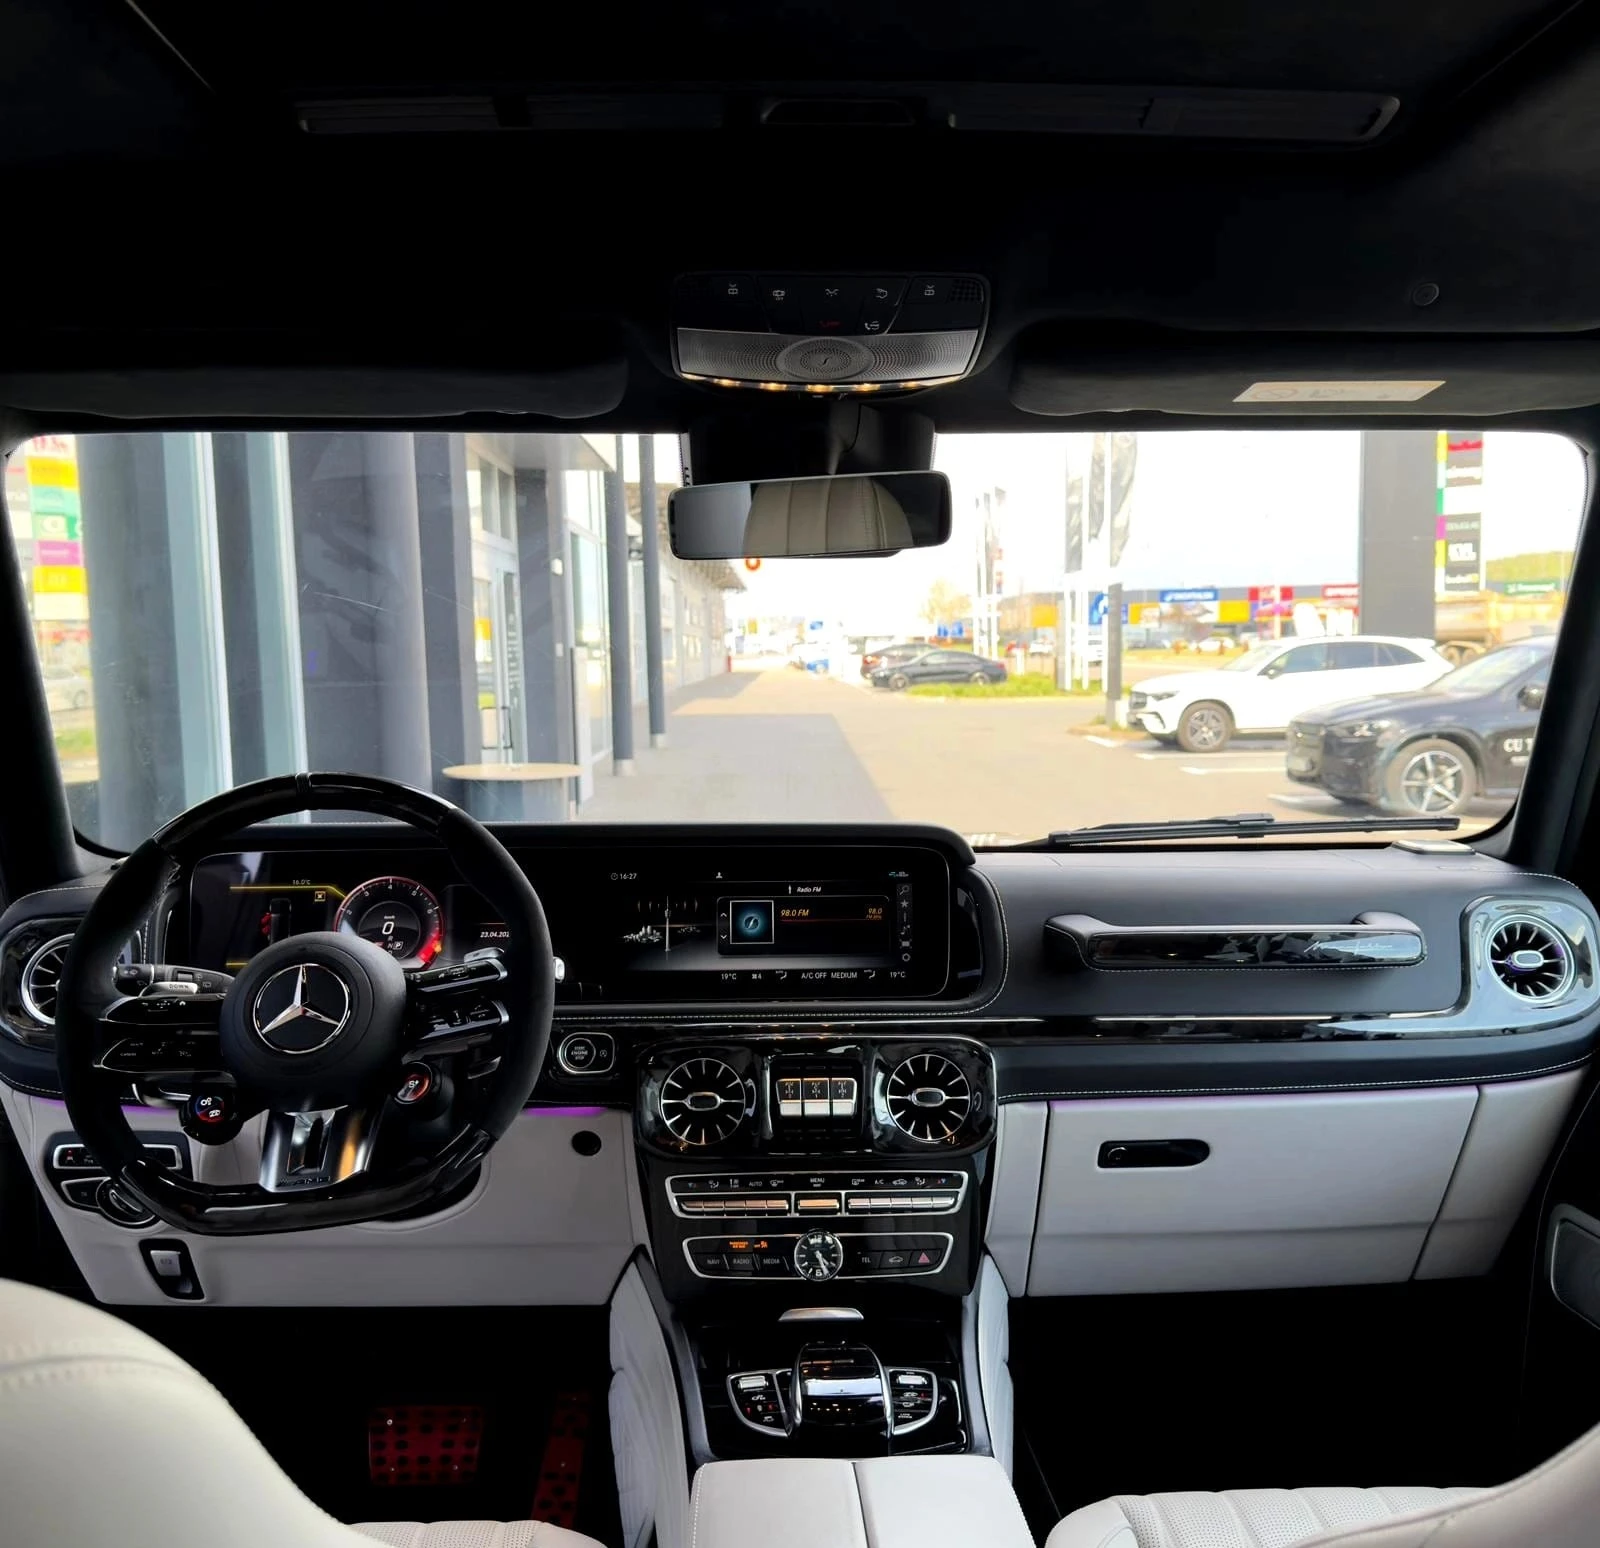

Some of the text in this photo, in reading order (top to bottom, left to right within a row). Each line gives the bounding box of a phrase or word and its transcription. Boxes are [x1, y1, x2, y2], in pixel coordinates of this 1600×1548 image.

[620, 872, 637, 880] 16:27
[781, 909, 809, 917] 98.0 FM
[868, 907, 882, 915] 98.0
[382, 921, 395, 935] 0
